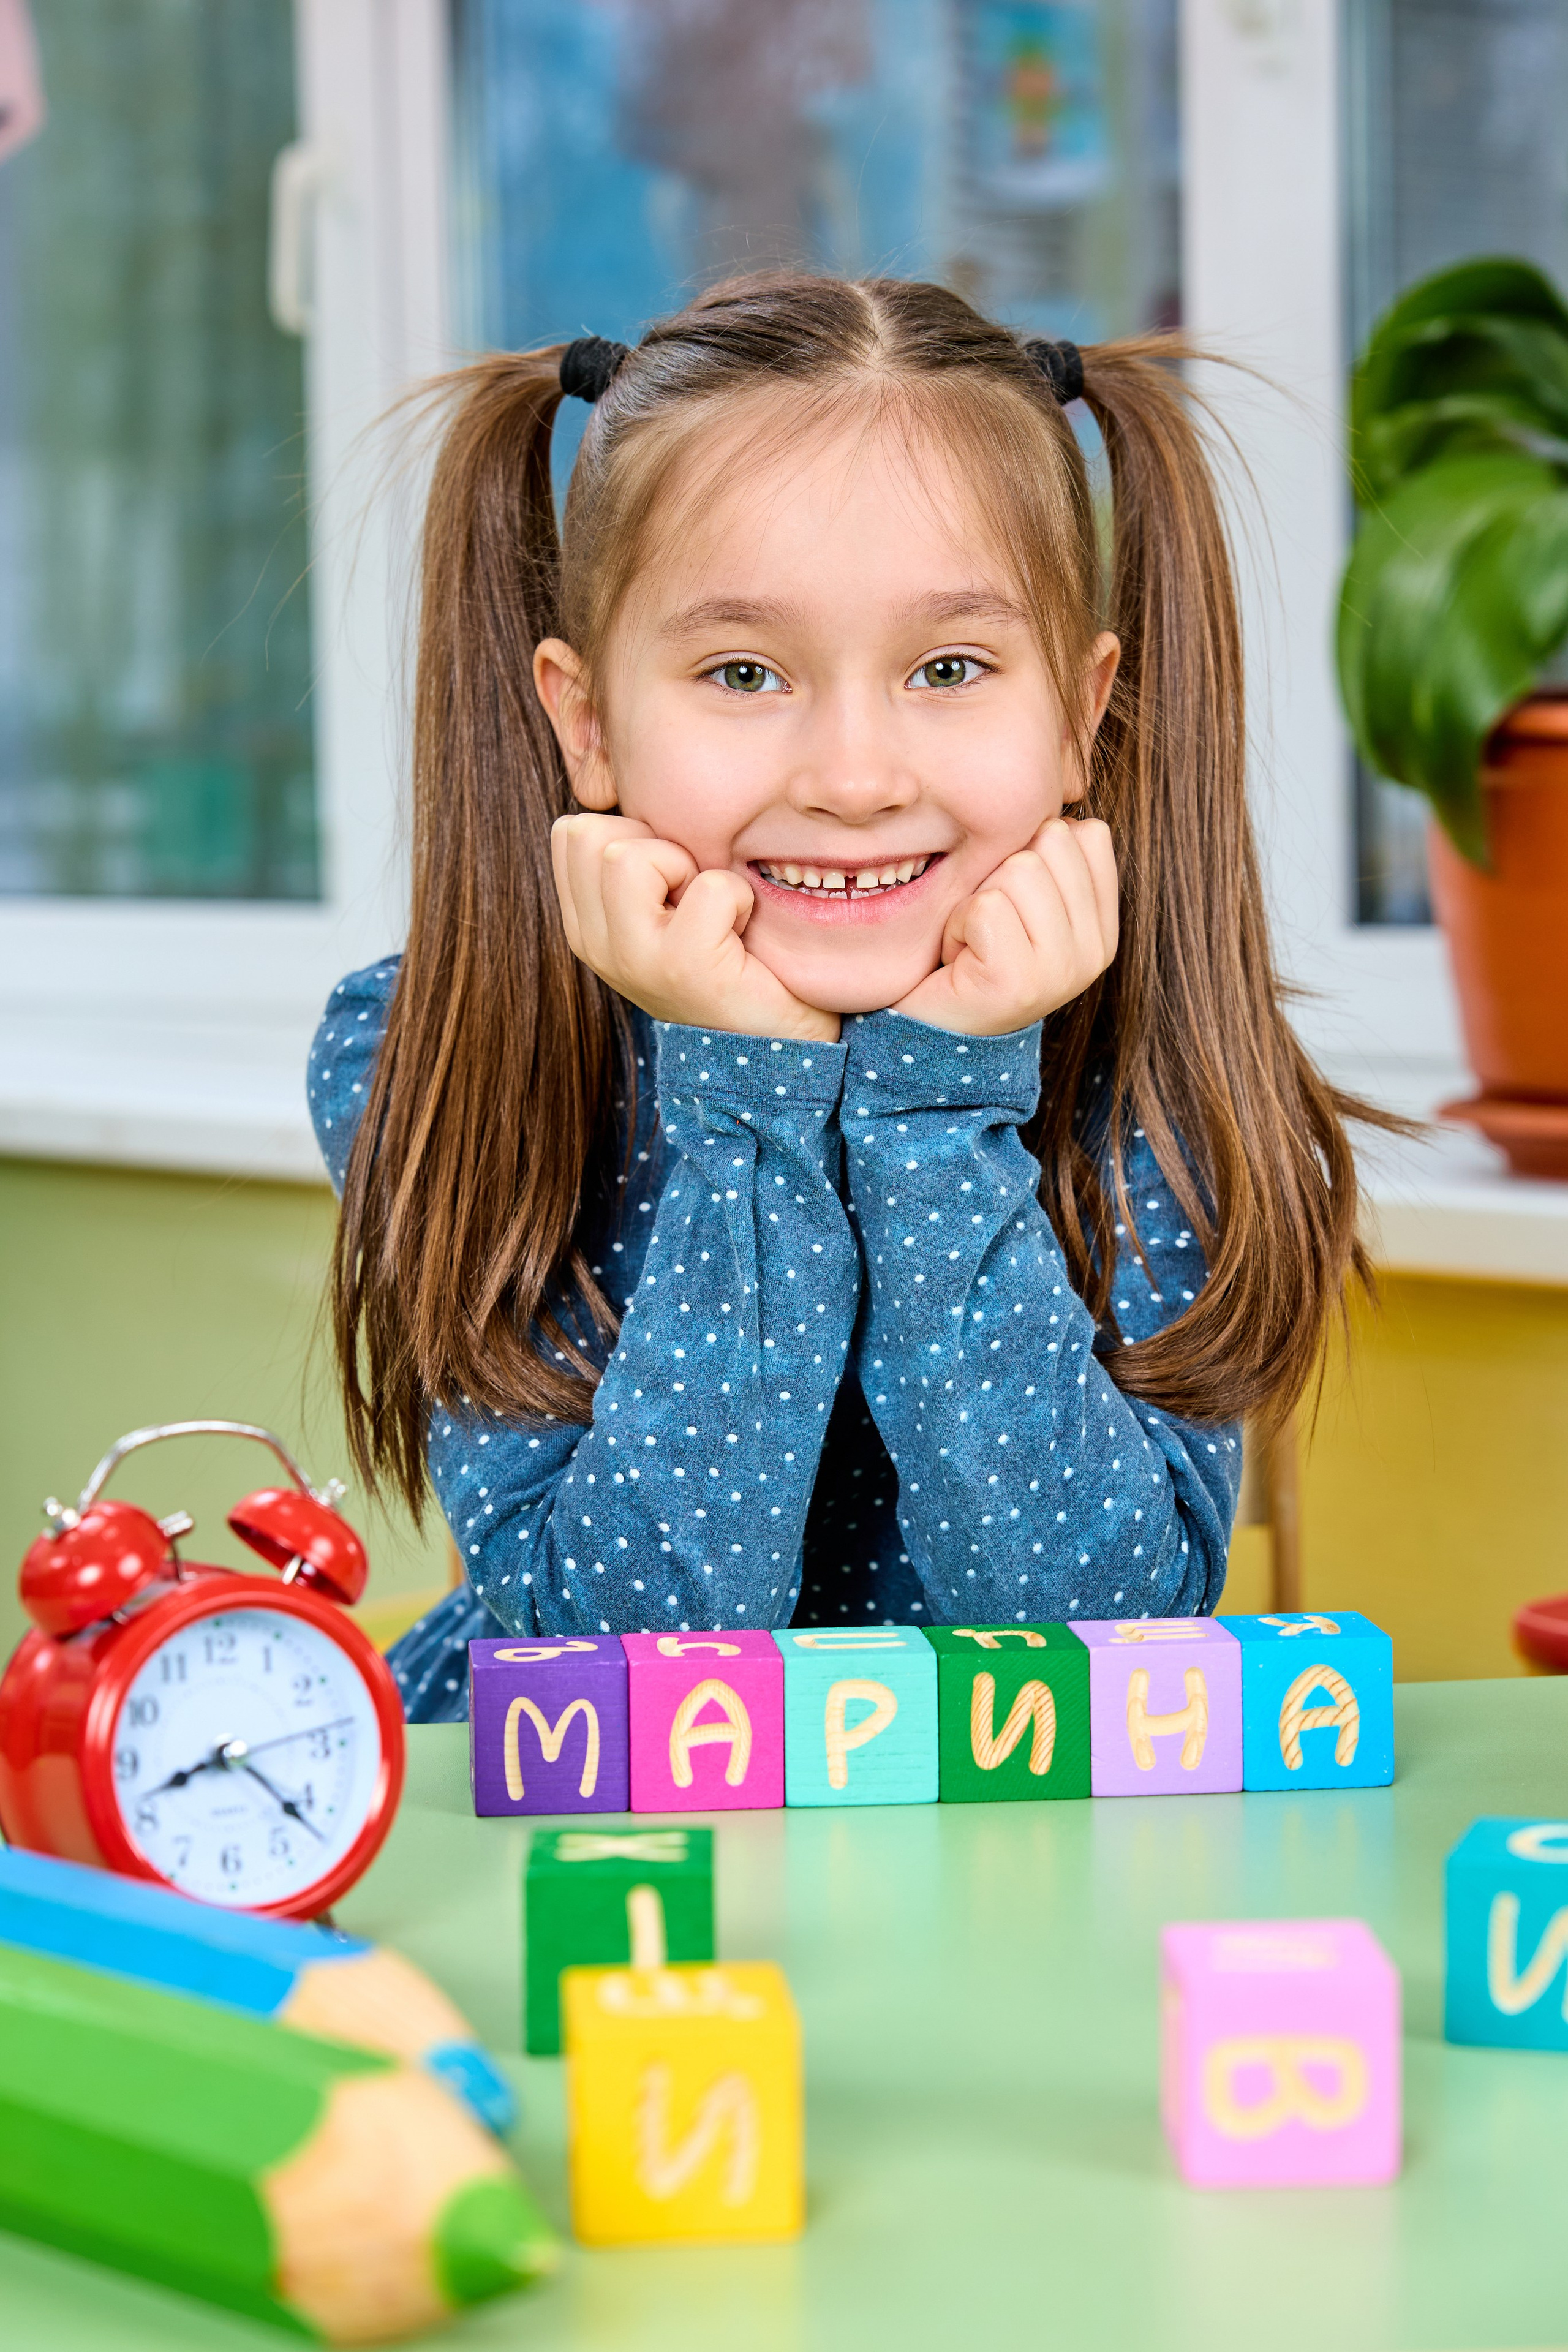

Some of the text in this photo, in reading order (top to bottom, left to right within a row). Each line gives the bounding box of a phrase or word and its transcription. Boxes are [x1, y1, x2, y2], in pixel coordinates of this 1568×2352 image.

[204, 1632, 239, 1664] 12
[263, 1645, 273, 1673] 1
[160, 1654, 187, 1683] 11
[293, 1675, 315, 1707] 2
[128, 1697, 159, 1727] 10
[308, 1729, 331, 1760] 3
[503, 1663, 1360, 1800] МАРИНА
[116, 1749, 138, 1778] 9
[135, 1801, 159, 1833] 8
[173, 1835, 193, 1868] 7
[270, 1826, 290, 1857] 5
[221, 1844, 242, 1875] 6
